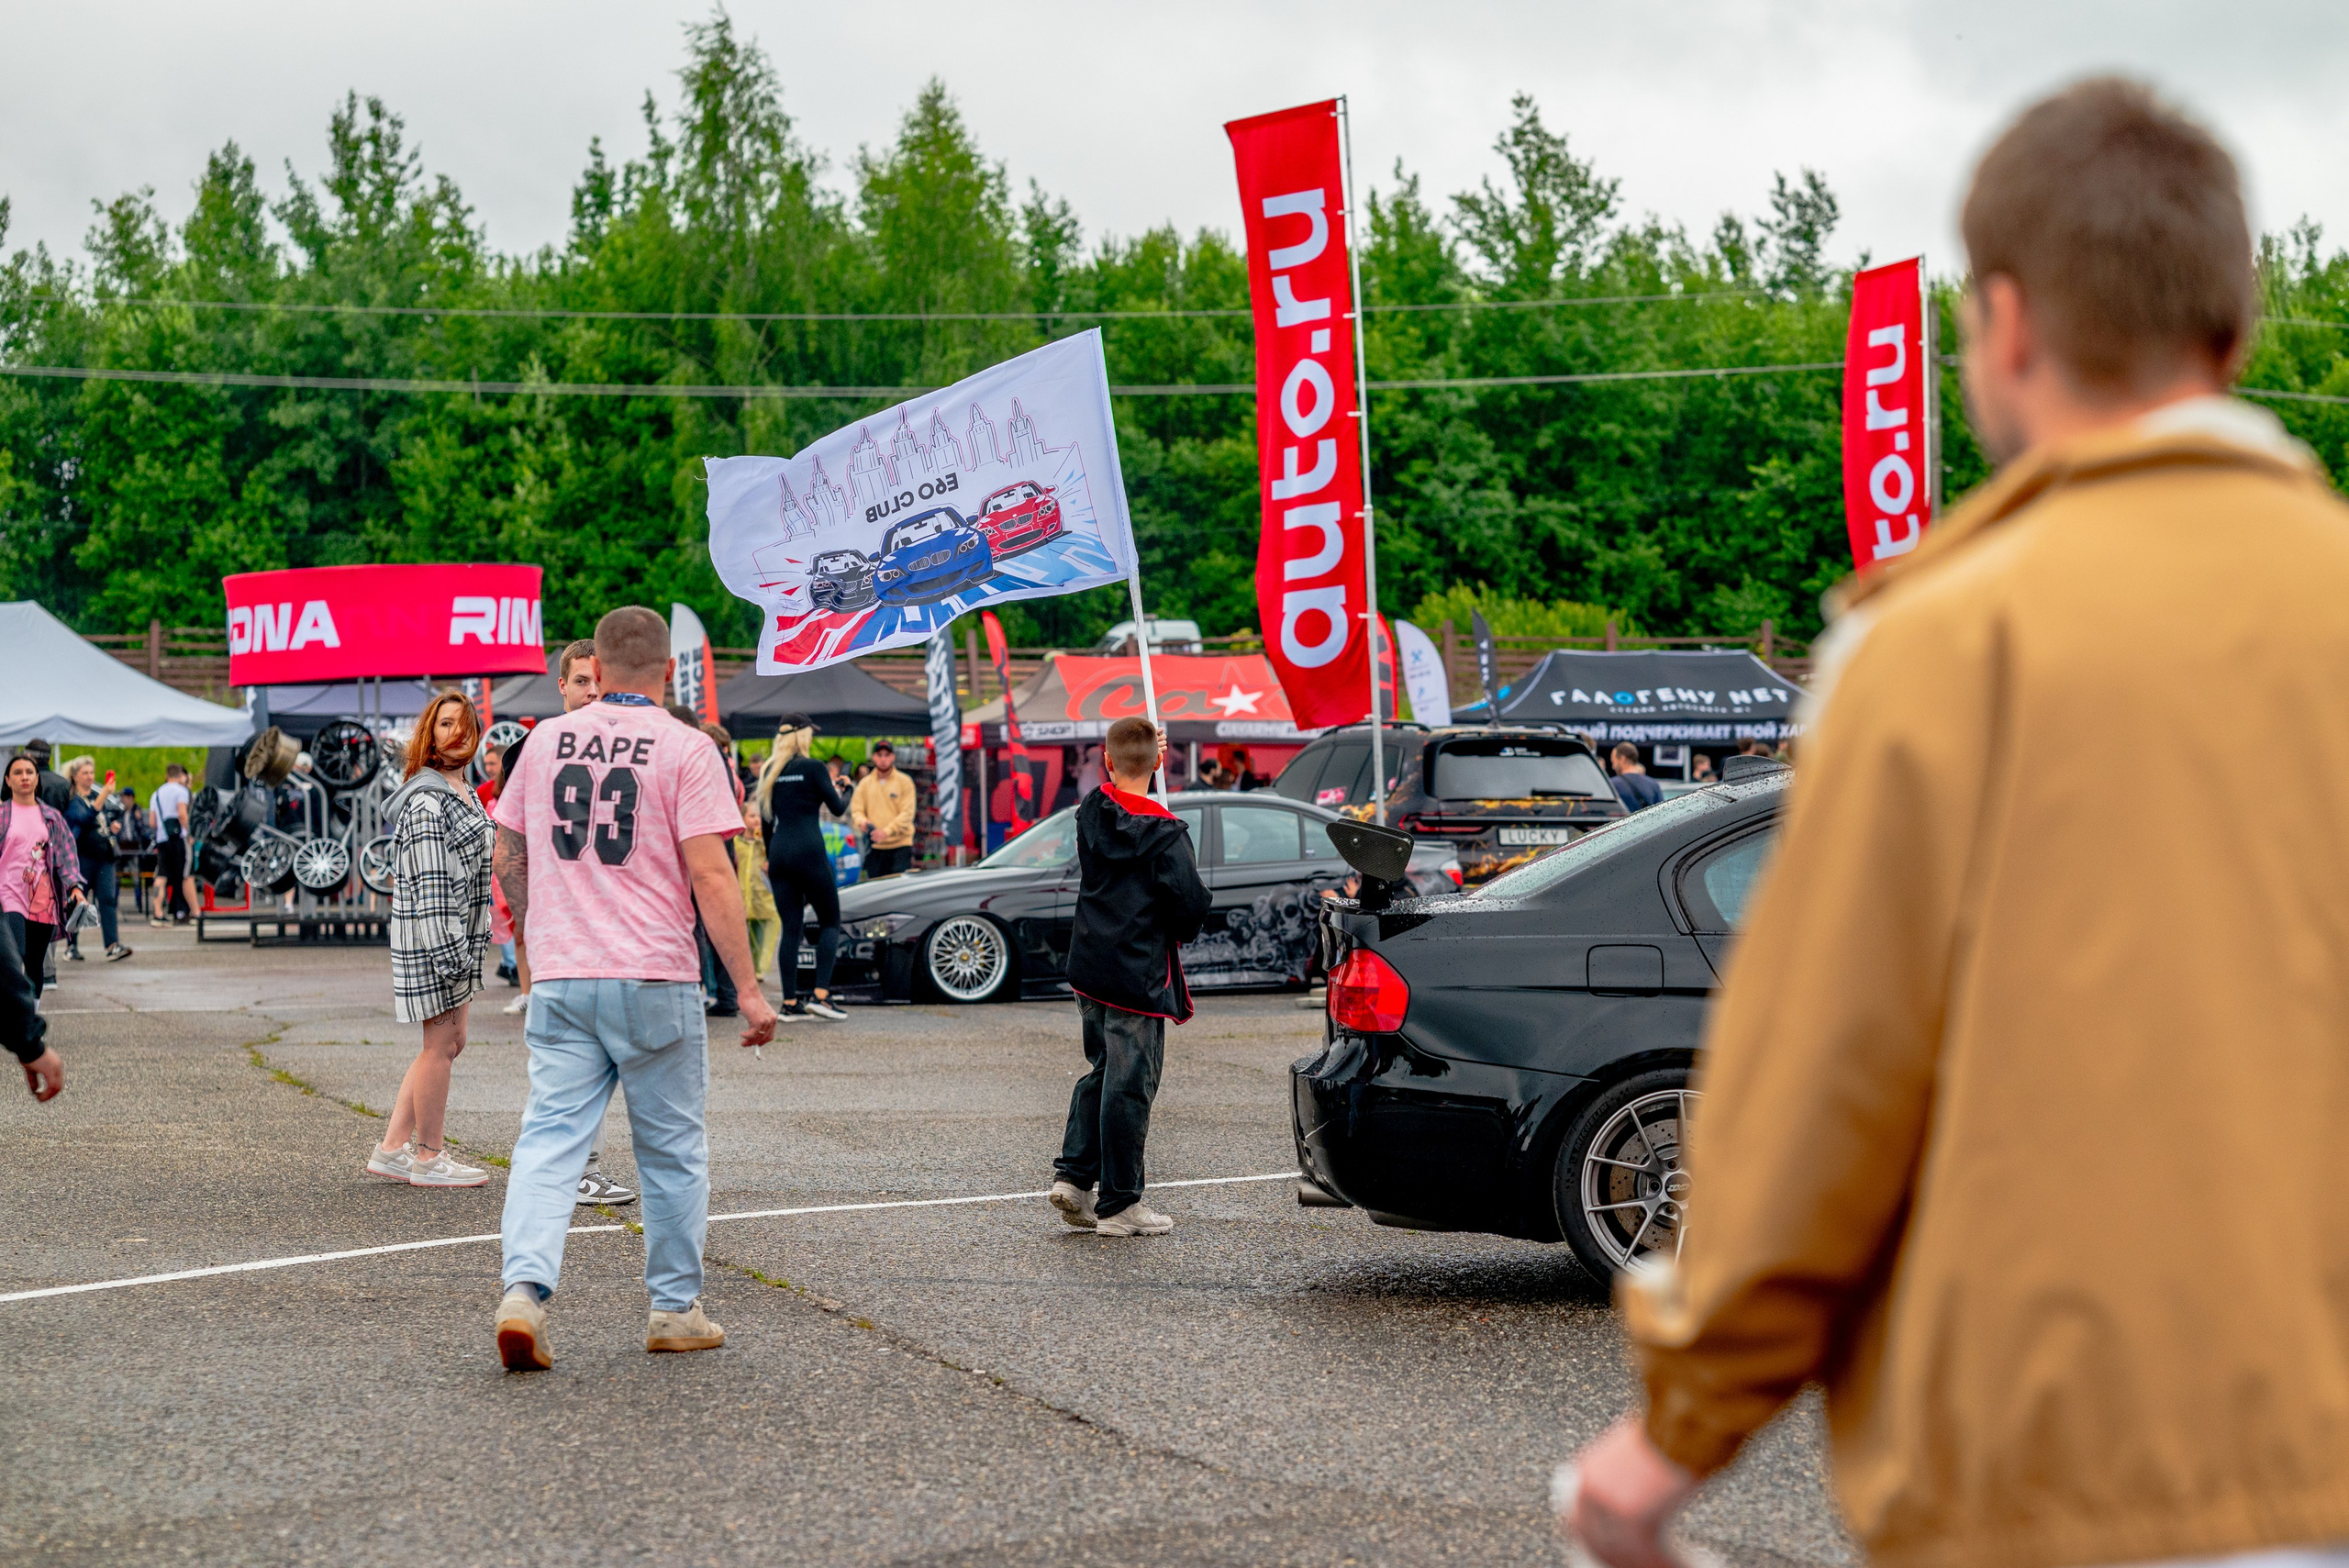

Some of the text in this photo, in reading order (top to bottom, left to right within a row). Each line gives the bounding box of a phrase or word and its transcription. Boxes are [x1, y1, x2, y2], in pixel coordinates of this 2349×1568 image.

[1262, 187, 1350, 669] auto.ru
[1865, 323, 1920, 562] to.ru
[556, 731, 655, 766] BAPE
[1609, 722, 1731, 742] ПОДЧЕРКИВАЕТ
[1733, 720, 1778, 740] ТВОЙ
[551, 763, 643, 867] 93
[1508, 829, 1559, 843] LUCKY
[1575, 1101, 1610, 1151] MICHELIN
